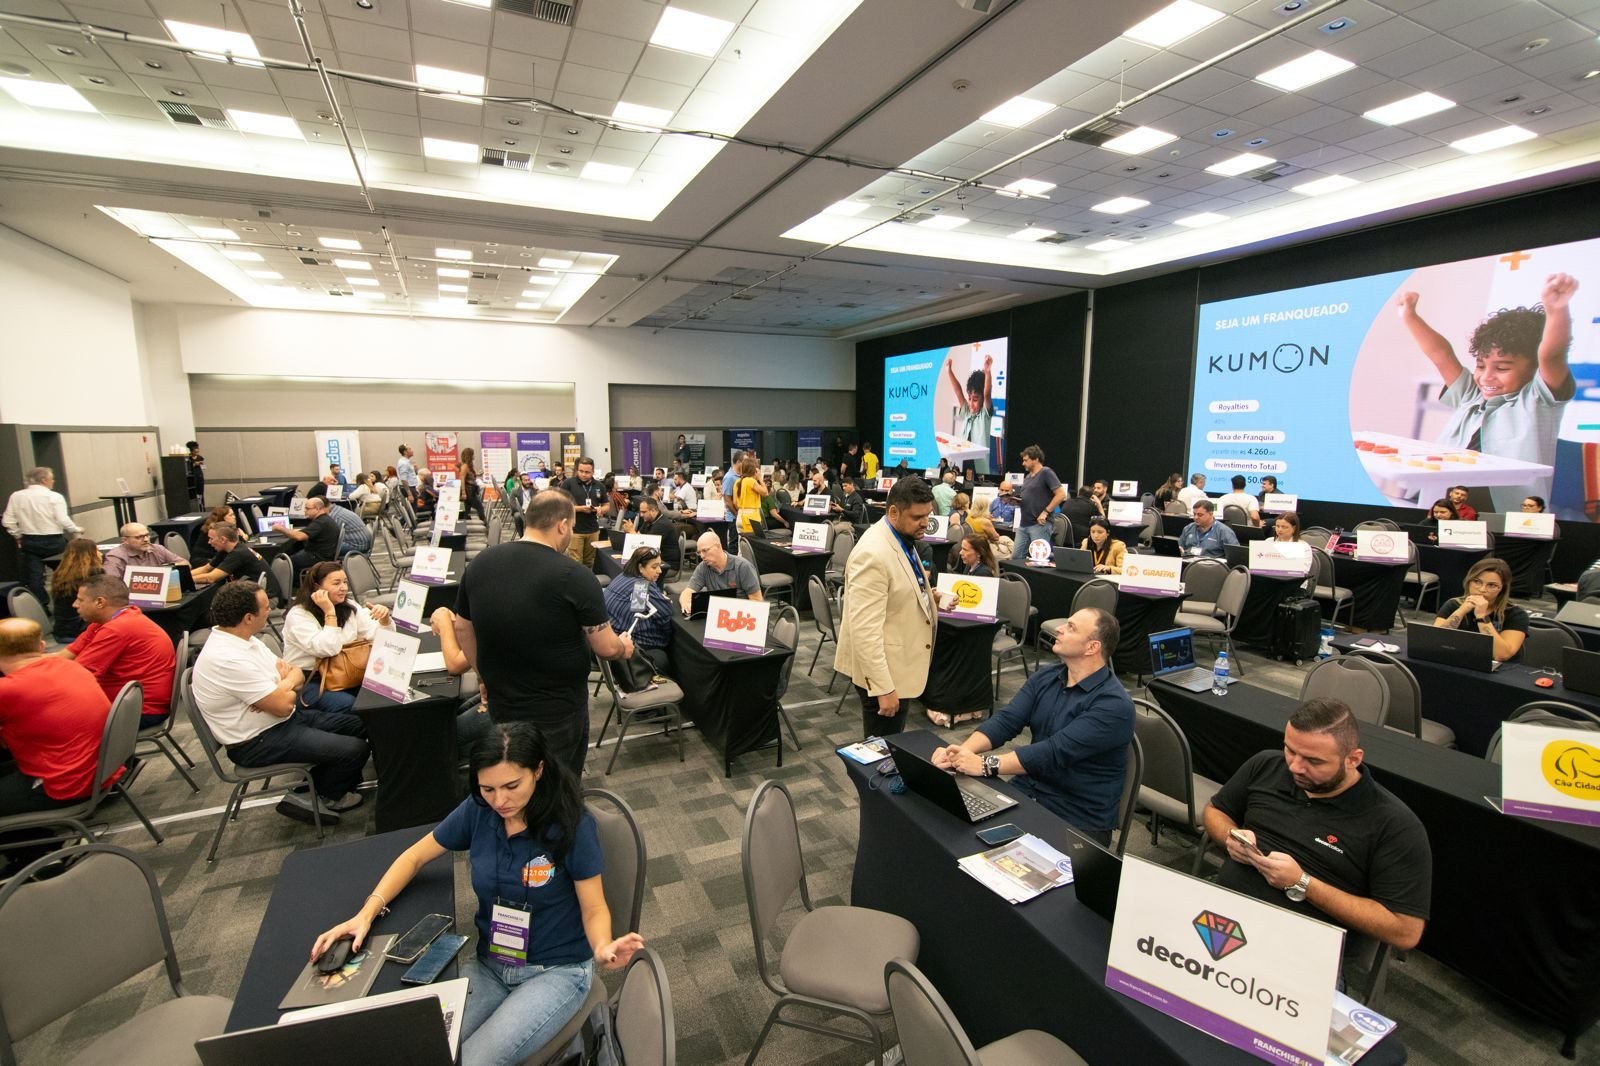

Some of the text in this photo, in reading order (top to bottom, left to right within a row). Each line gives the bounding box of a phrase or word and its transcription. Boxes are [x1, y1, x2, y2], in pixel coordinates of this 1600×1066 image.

[1215, 303, 1349, 330] SEJA UM FRANQUEADO
[1208, 343, 1330, 374] KUMON
[888, 382, 928, 400] KUMON
[1218, 402, 1249, 412] Royalties
[1216, 433, 1275, 443] Taxa de Franquia
[1213, 461, 1277, 471] Investimento Total
[132, 575, 160, 584] BRASIL
[131, 583, 159, 591] CACAU
[717, 608, 757, 633] Bob's
[1136, 935, 1300, 1018] decorcolors
